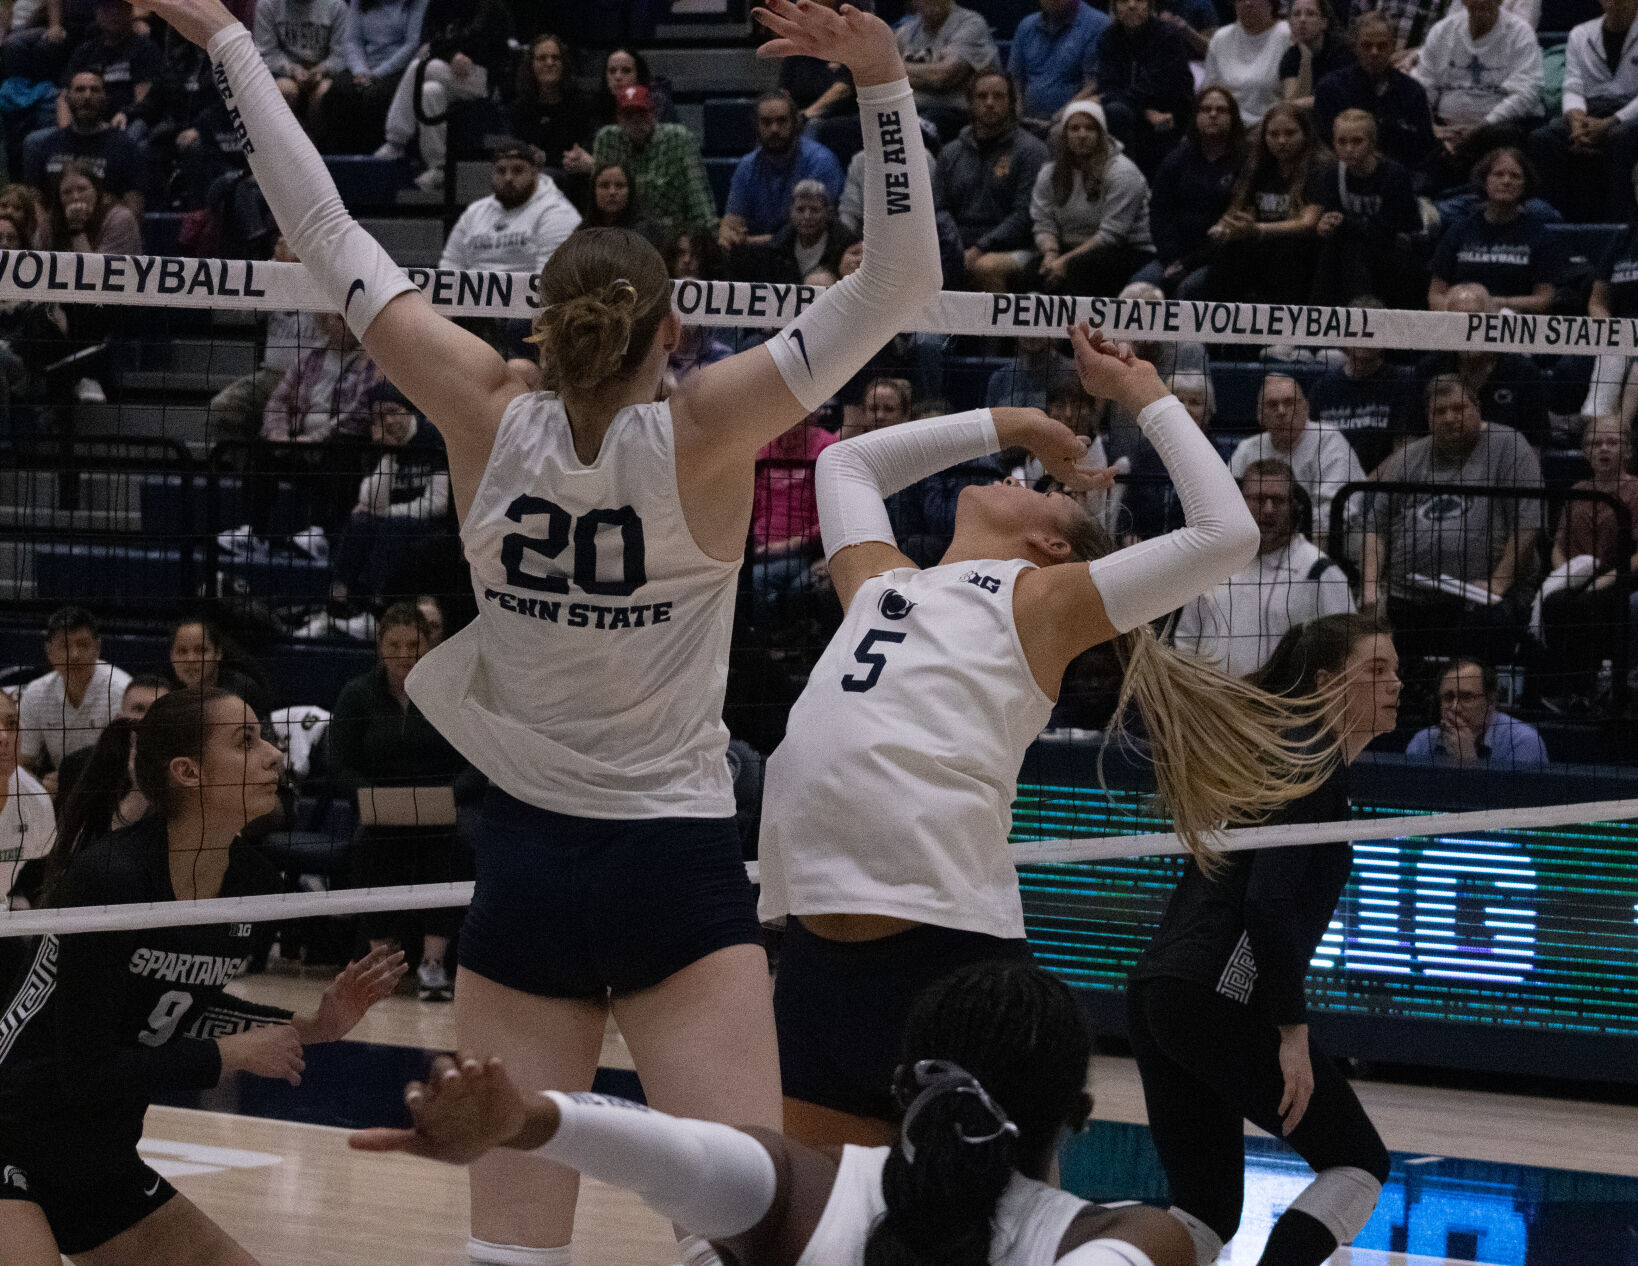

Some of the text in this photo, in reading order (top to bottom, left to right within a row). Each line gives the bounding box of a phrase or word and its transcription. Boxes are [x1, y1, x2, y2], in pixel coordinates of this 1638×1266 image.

[878, 110, 911, 215] WE ARE
[408, 268, 512, 307] PENN
[671, 279, 815, 318] OLLEYB
[991, 293, 1374, 338] PENN STATE VOLLEYBALL
[1466, 313, 1536, 344] PENN
[1544, 316, 1621, 347] STATE
[500, 493, 648, 597] 20
[567, 601, 673, 630] STATE
[841, 629, 906, 692] 5
[128, 947, 242, 986] SPARTANS
[137, 990, 194, 1047] 9
